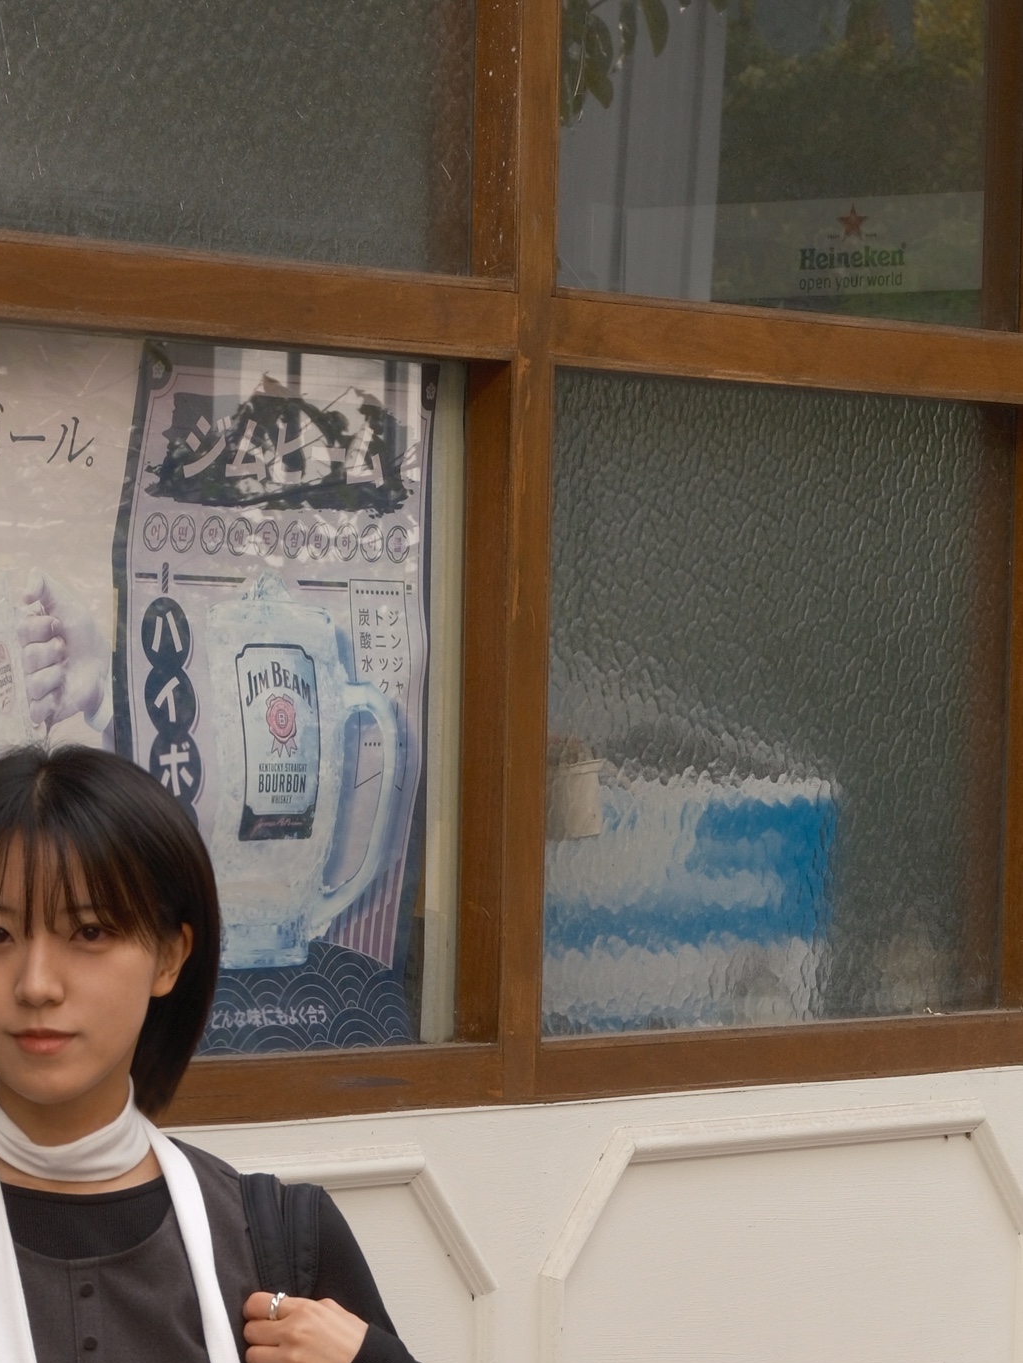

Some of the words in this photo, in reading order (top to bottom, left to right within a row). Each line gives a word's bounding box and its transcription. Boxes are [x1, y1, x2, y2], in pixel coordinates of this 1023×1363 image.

[799, 245, 905, 270] Heineken
[799, 277, 831, 293] open
[836, 275, 864, 291] your
[867, 271, 903, 287] world
[358, 608, 374, 673] 炭酸水
[245, 669, 270, 707] JIM
[270, 661, 312, 708] BEAM
[151, 610, 195, 797] ハイボ
[258, 773, 306, 793] BOURBON
